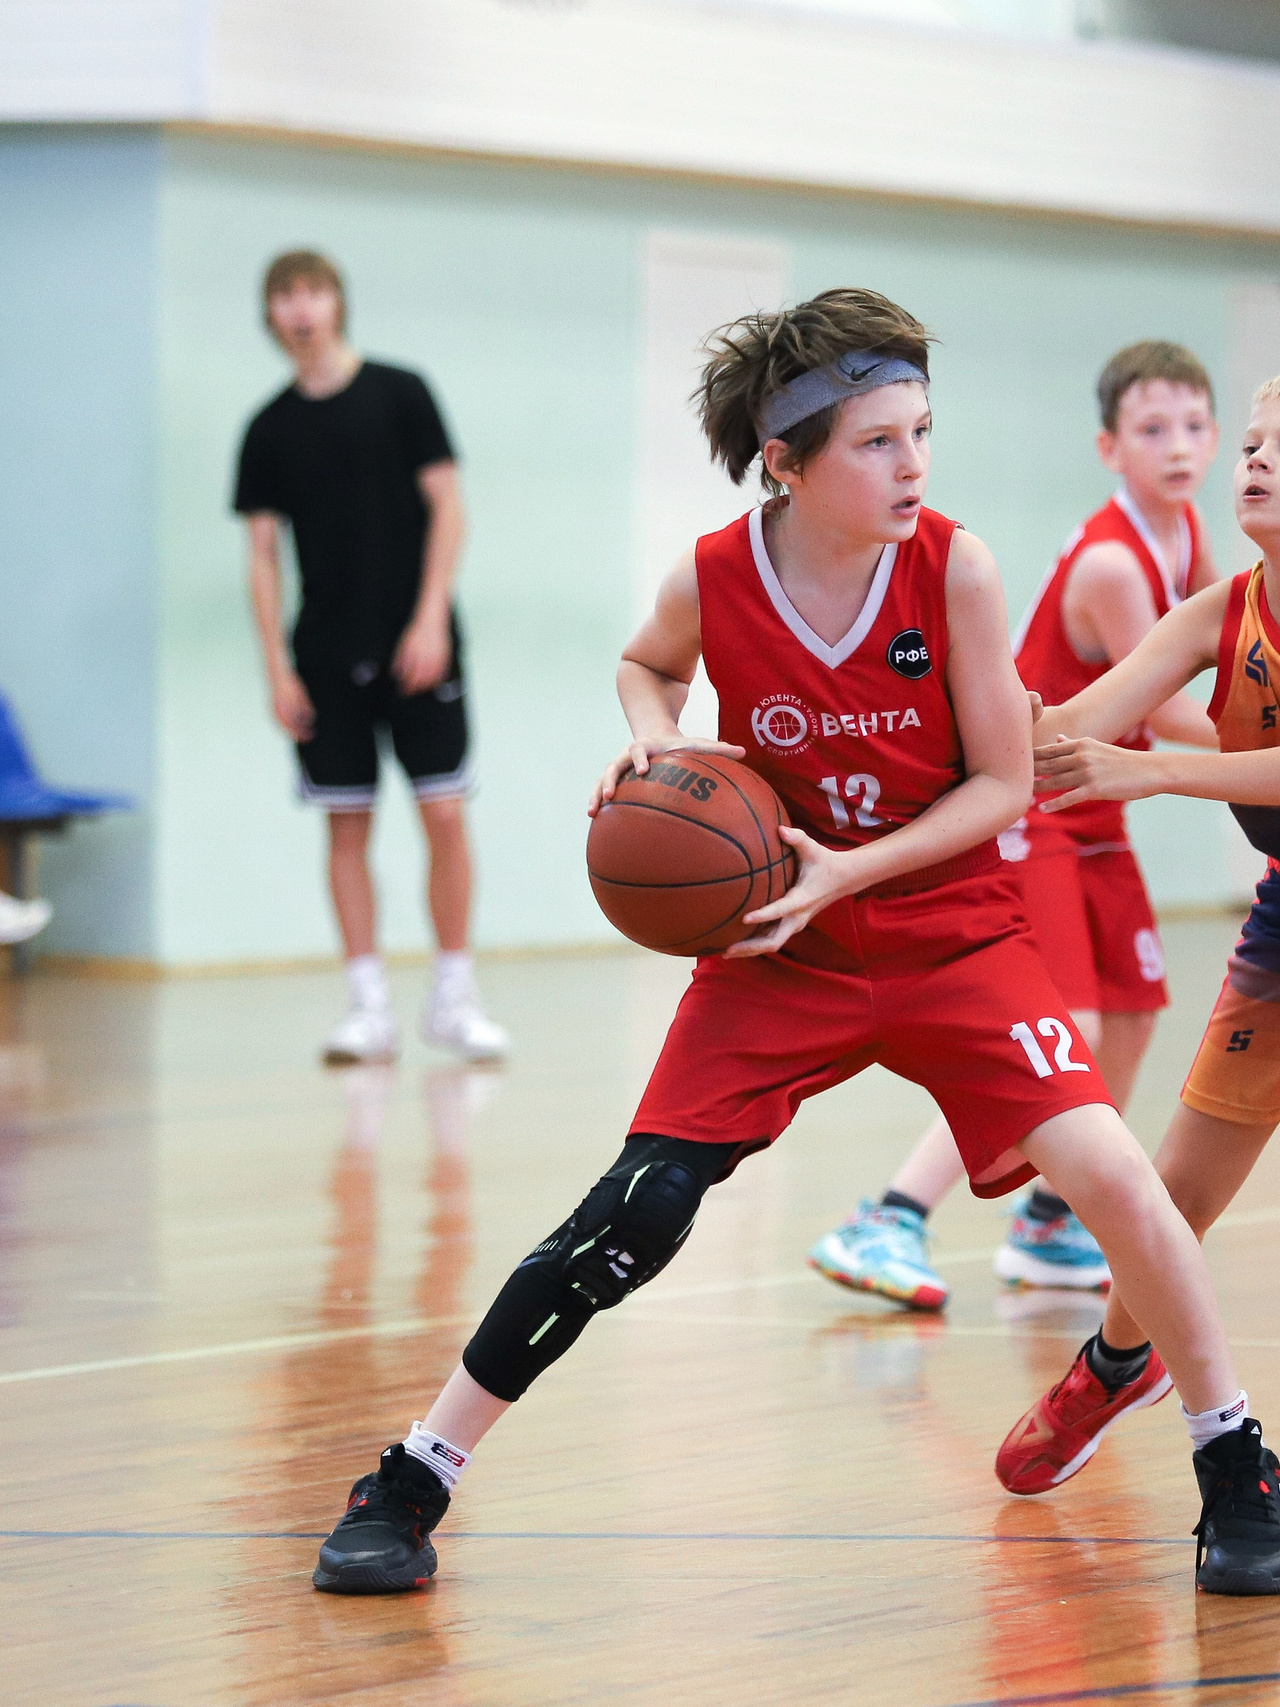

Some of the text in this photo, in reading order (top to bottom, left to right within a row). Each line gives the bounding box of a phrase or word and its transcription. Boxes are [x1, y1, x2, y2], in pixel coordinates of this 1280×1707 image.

[759, 693, 802, 708] ЮВЕНТА
[816, 773, 886, 830] 12
[1008, 1016, 1092, 1080] 12
